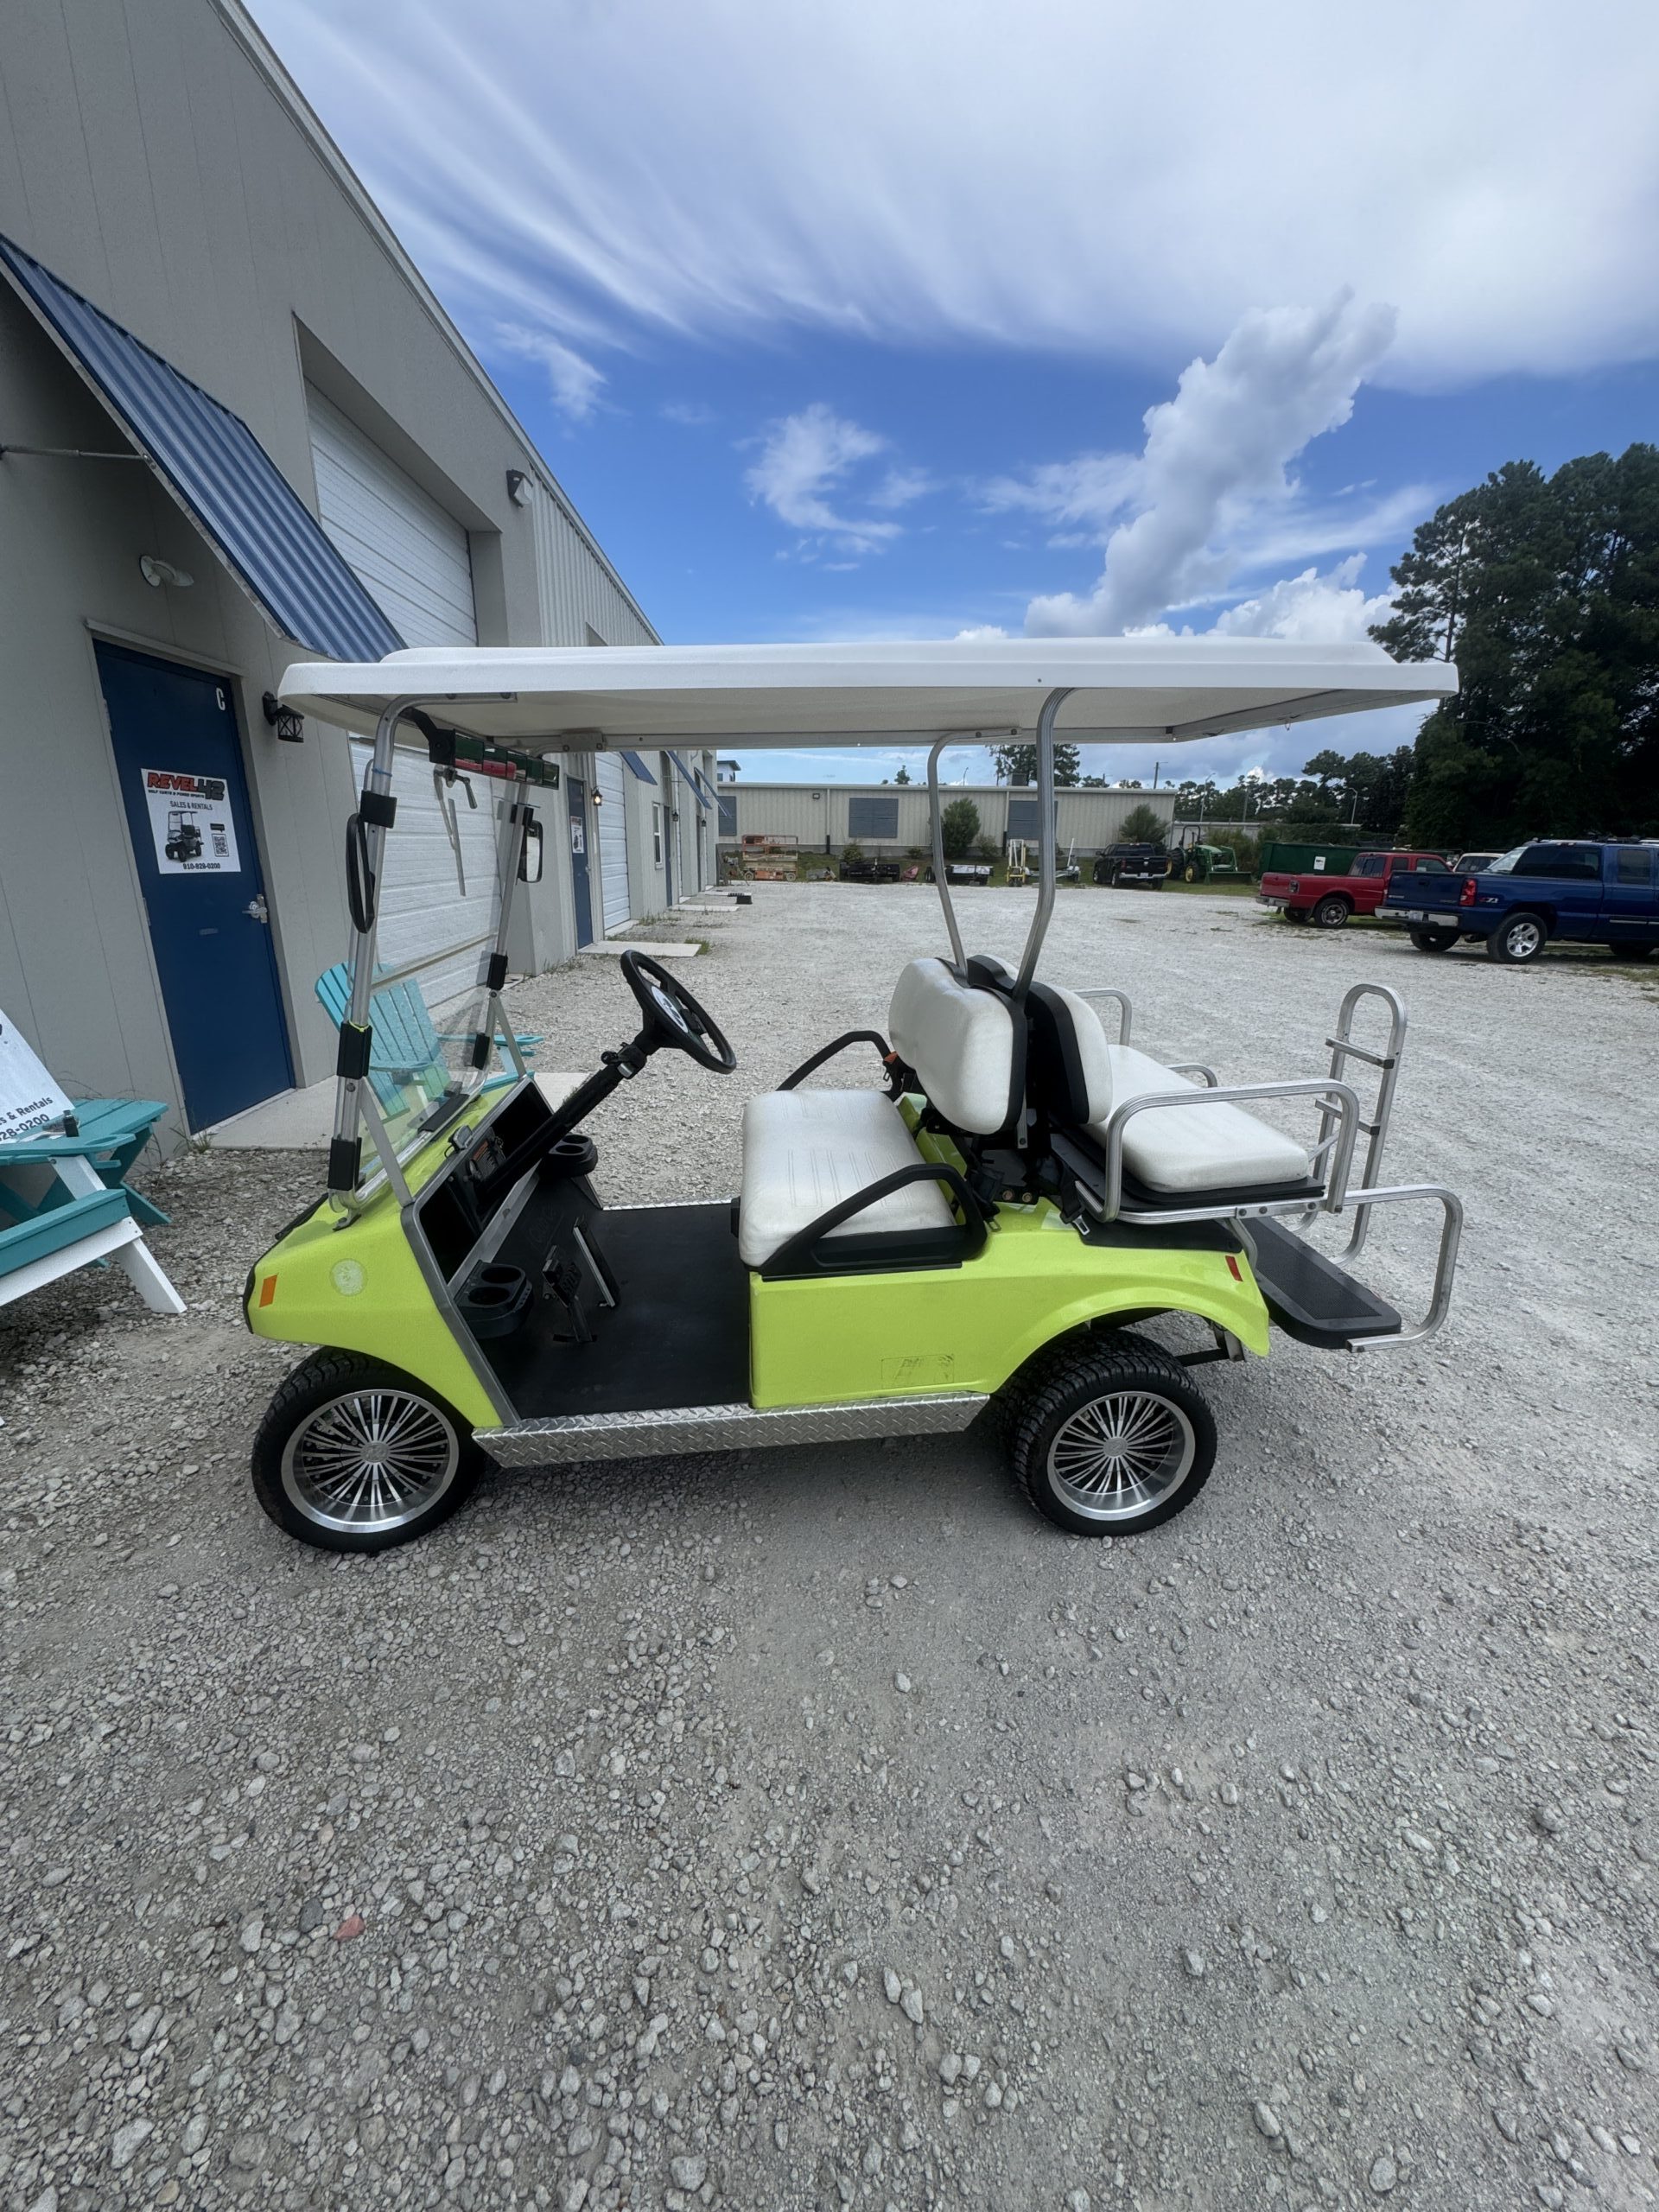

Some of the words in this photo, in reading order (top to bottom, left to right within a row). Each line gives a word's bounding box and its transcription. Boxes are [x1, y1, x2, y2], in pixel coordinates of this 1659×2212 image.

[216, 688, 226, 710] C
[170, 800, 186, 809] SALES
[6, 1111, 18, 1120] &
[16, 1096, 54, 1116] Rentals
[0, 1114, 50, 1141] 28-0200
